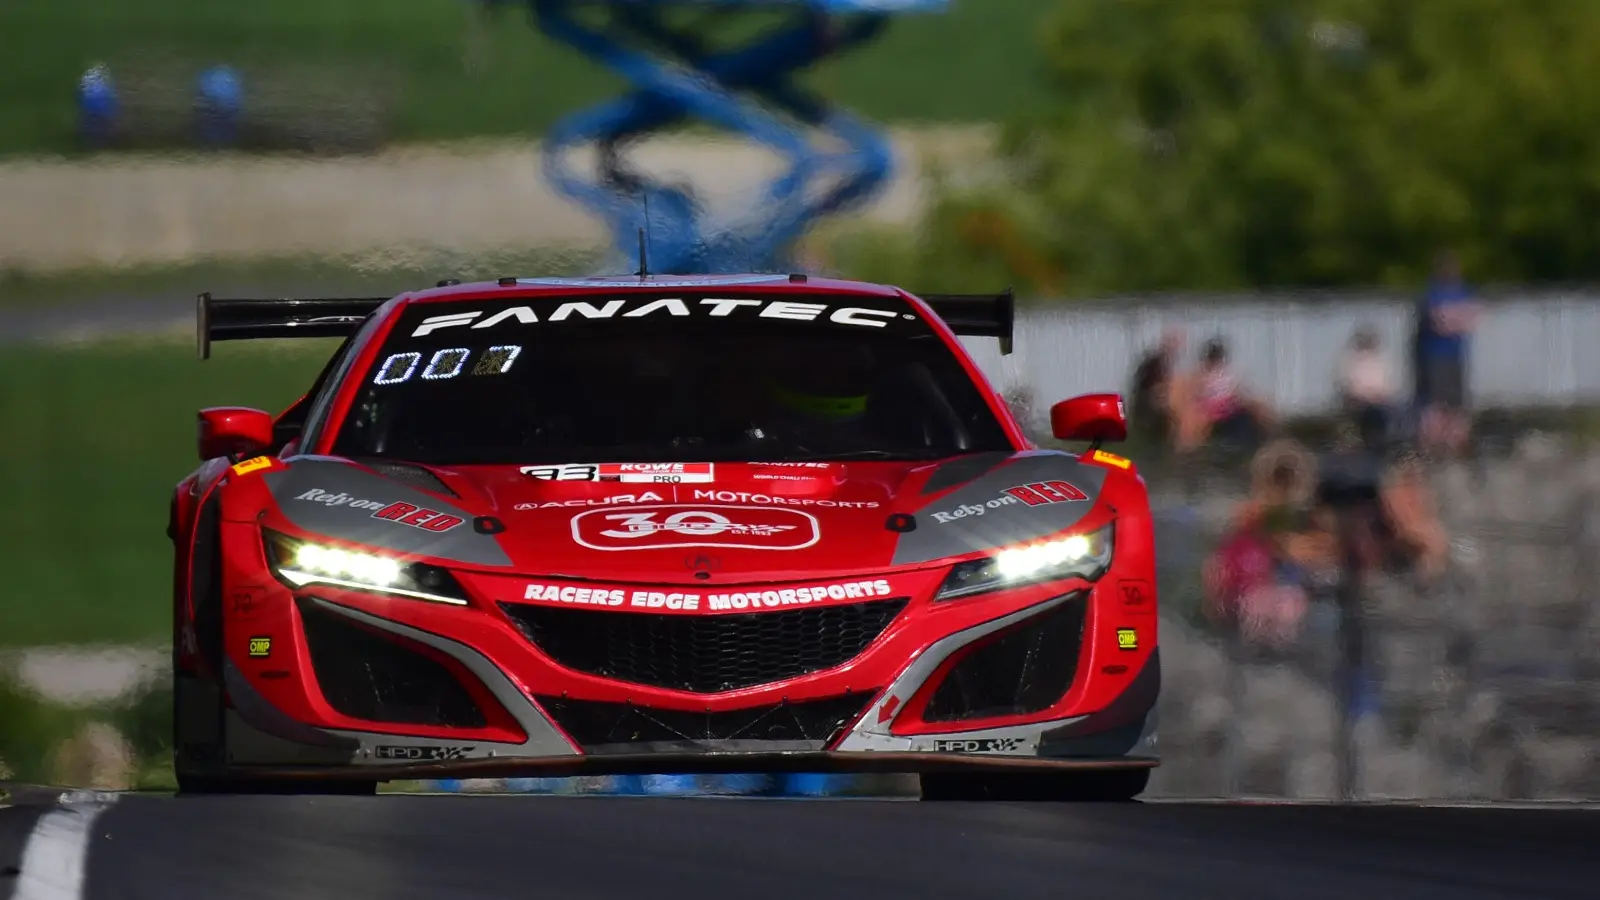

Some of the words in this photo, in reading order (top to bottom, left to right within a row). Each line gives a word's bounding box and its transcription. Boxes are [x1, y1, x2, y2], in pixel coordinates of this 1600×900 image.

[411, 298, 897, 336] FANATEC
[620, 463, 684, 471] ROWE
[653, 475, 681, 484] PRO
[540, 491, 664, 508] ACURA
[694, 490, 880, 509] MOTORSPORTS
[930, 502, 986, 524] Rely
[1001, 479, 1090, 508] RED
[294, 488, 350, 507] Rely
[370, 500, 466, 533] RED
[524, 584, 625, 606] RACERS
[631, 591, 700, 610] EDGE
[707, 580, 891, 610] MOTORSPORTS
[1118, 632, 1136, 646] OMP
[249, 641, 270, 653] OMP
[376, 746, 423, 759] HPD
[934, 740, 980, 752] HPD
